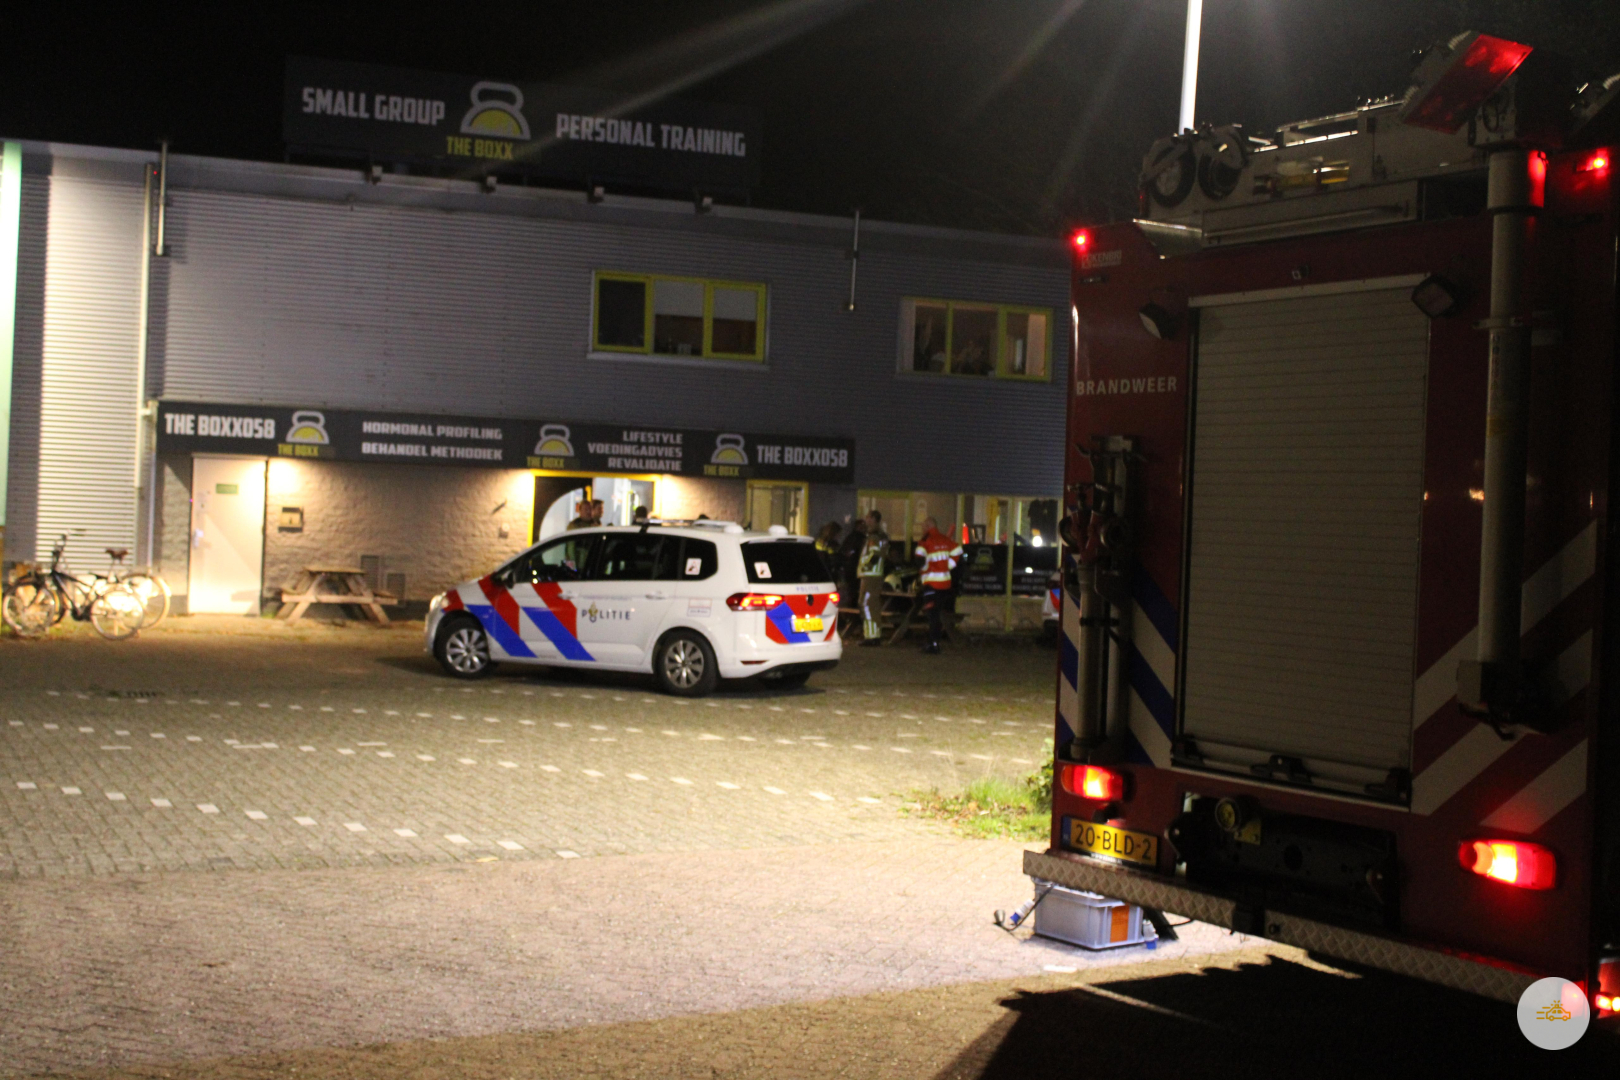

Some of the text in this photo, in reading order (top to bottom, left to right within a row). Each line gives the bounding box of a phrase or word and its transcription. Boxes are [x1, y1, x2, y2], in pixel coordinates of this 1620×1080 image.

[302, 87, 446, 125] SMALL GROUP
[556, 113, 747, 157] PERSONAL TRAINING
[447, 136, 514, 160] THE BOXX
[1076, 376, 1178, 396] BRANDWEER
[164, 413, 196, 435] THE
[362, 421, 503, 440] HORMONAL PROFILING
[623, 431, 683, 444] LIFESTYLE
[361, 442, 503, 460] BEHANDEL METHODIEK
[587, 442, 683, 458] VOEDINGADVIES
[757, 445, 782, 464] THE
[608, 457, 682, 471] REVALIDATIE
[581, 609, 631, 623] POLITIE
[1075, 823, 1151, 860] 20-BLD-2
